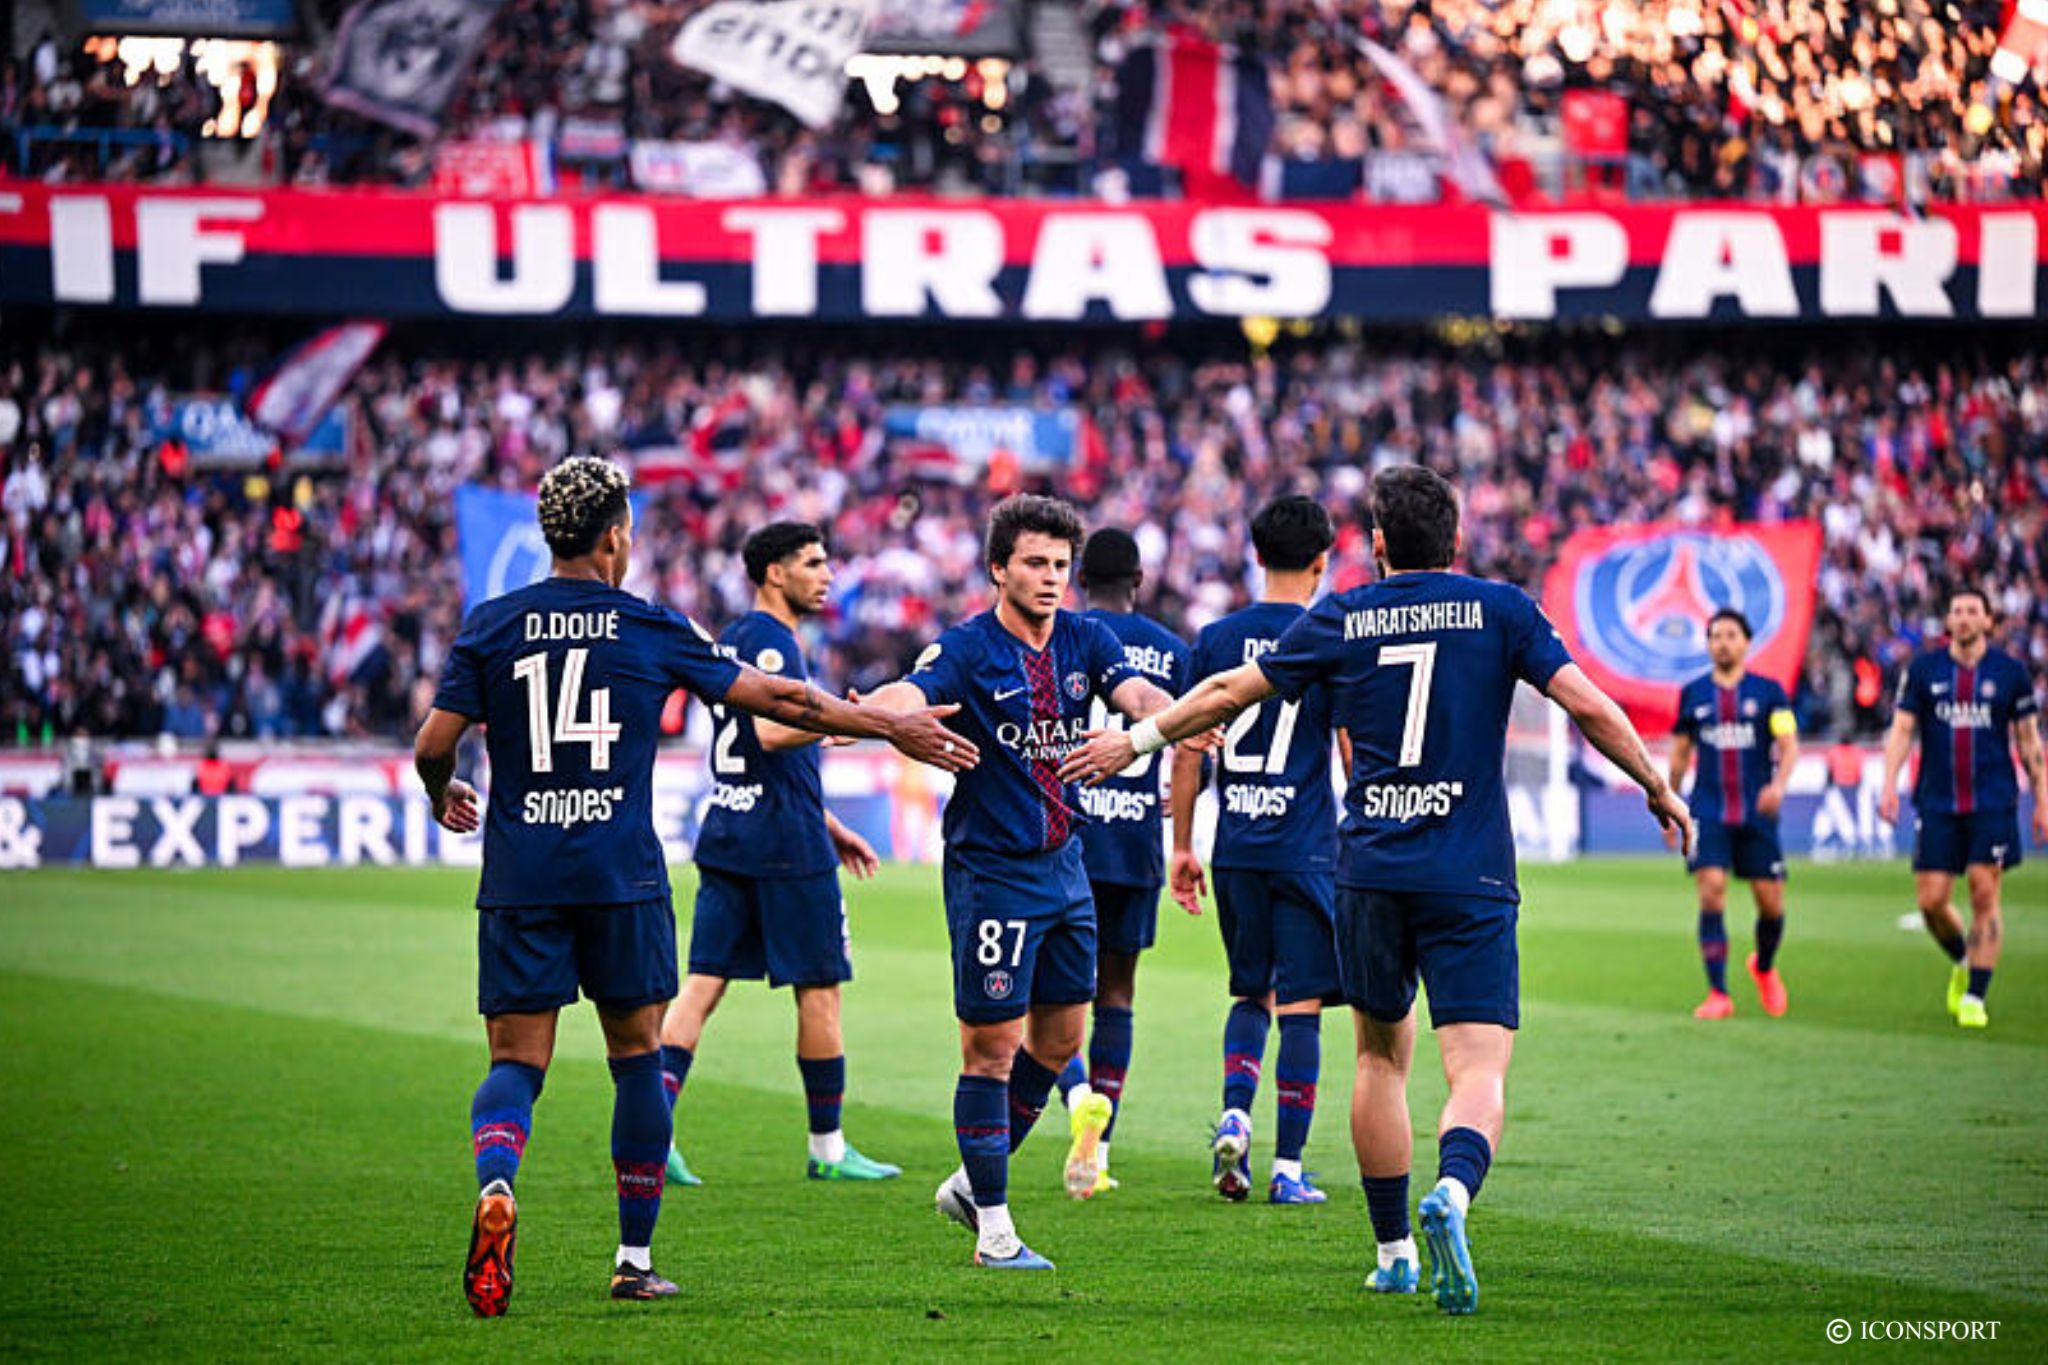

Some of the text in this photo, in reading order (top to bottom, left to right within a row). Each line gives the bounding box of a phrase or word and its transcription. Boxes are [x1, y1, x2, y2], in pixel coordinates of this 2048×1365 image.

[0, 192, 2037, 318] IF ULTRAS PARI
[525, 610, 619, 641] D.DOUÉ
[1344, 600, 1483, 641] KVARATSKHELIA
[513, 648, 622, 772] 14
[1377, 641, 1437, 767] 7
[997, 718, 1088, 749] QATAR
[523, 788, 613, 829] snipes
[1364, 781, 1452, 823] snipes
[978, 919, 1027, 967] 87
